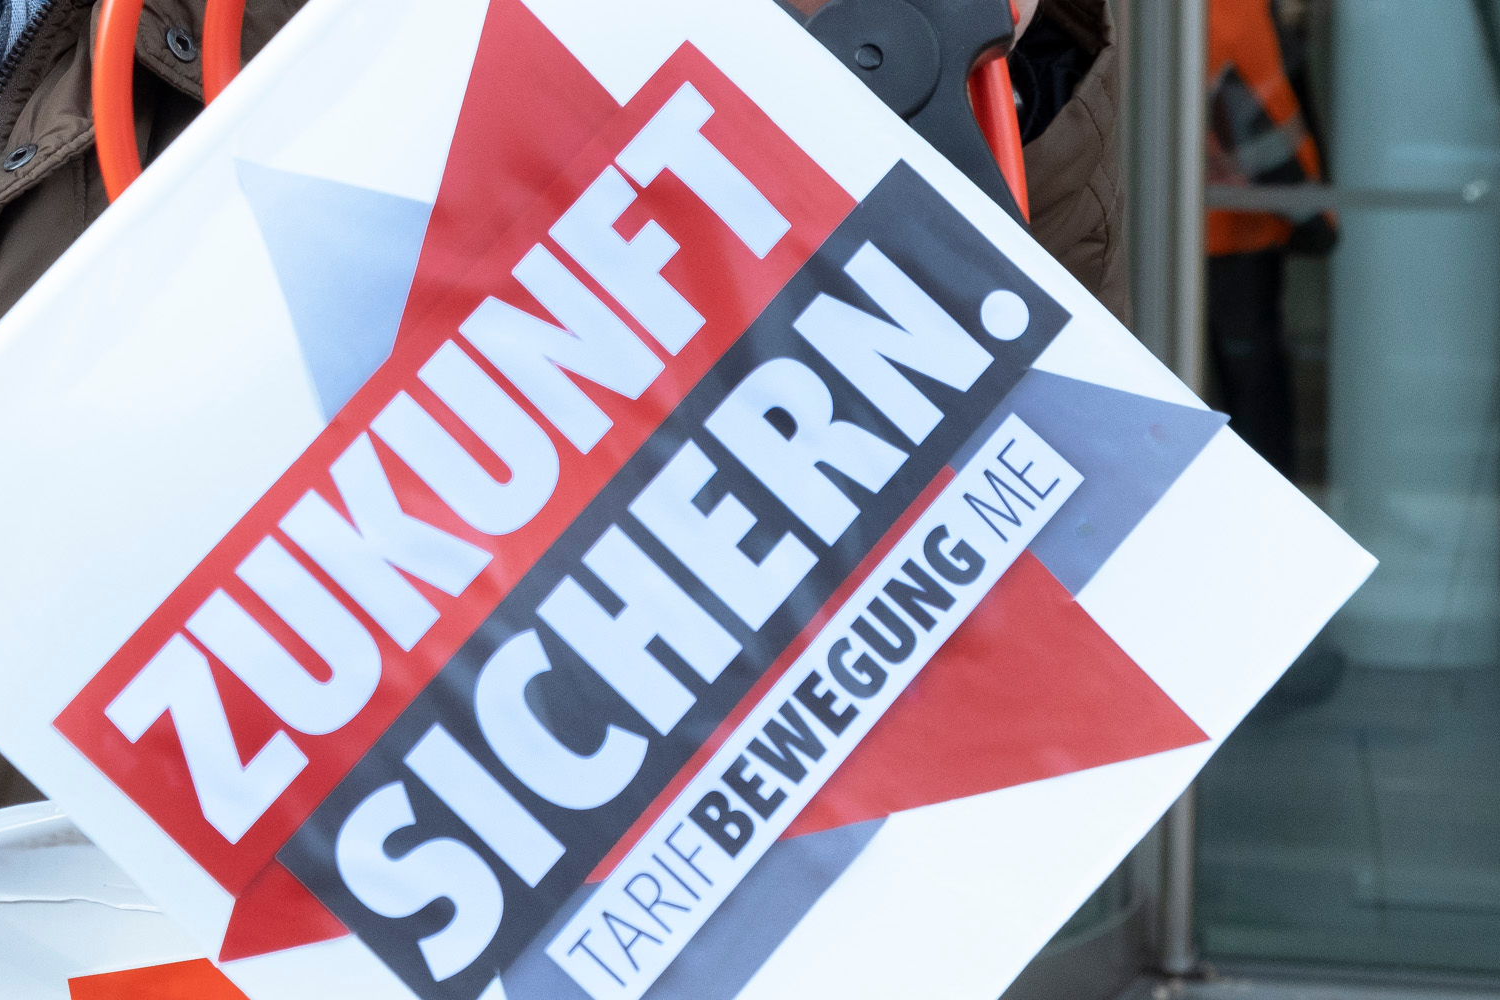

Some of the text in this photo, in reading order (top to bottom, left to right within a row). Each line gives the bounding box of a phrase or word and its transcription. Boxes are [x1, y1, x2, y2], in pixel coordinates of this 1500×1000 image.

[103, 80, 792, 844] ZUKUNFT
[334, 239, 1031, 982] SICHERN.
[962, 438, 1061, 545] ME
